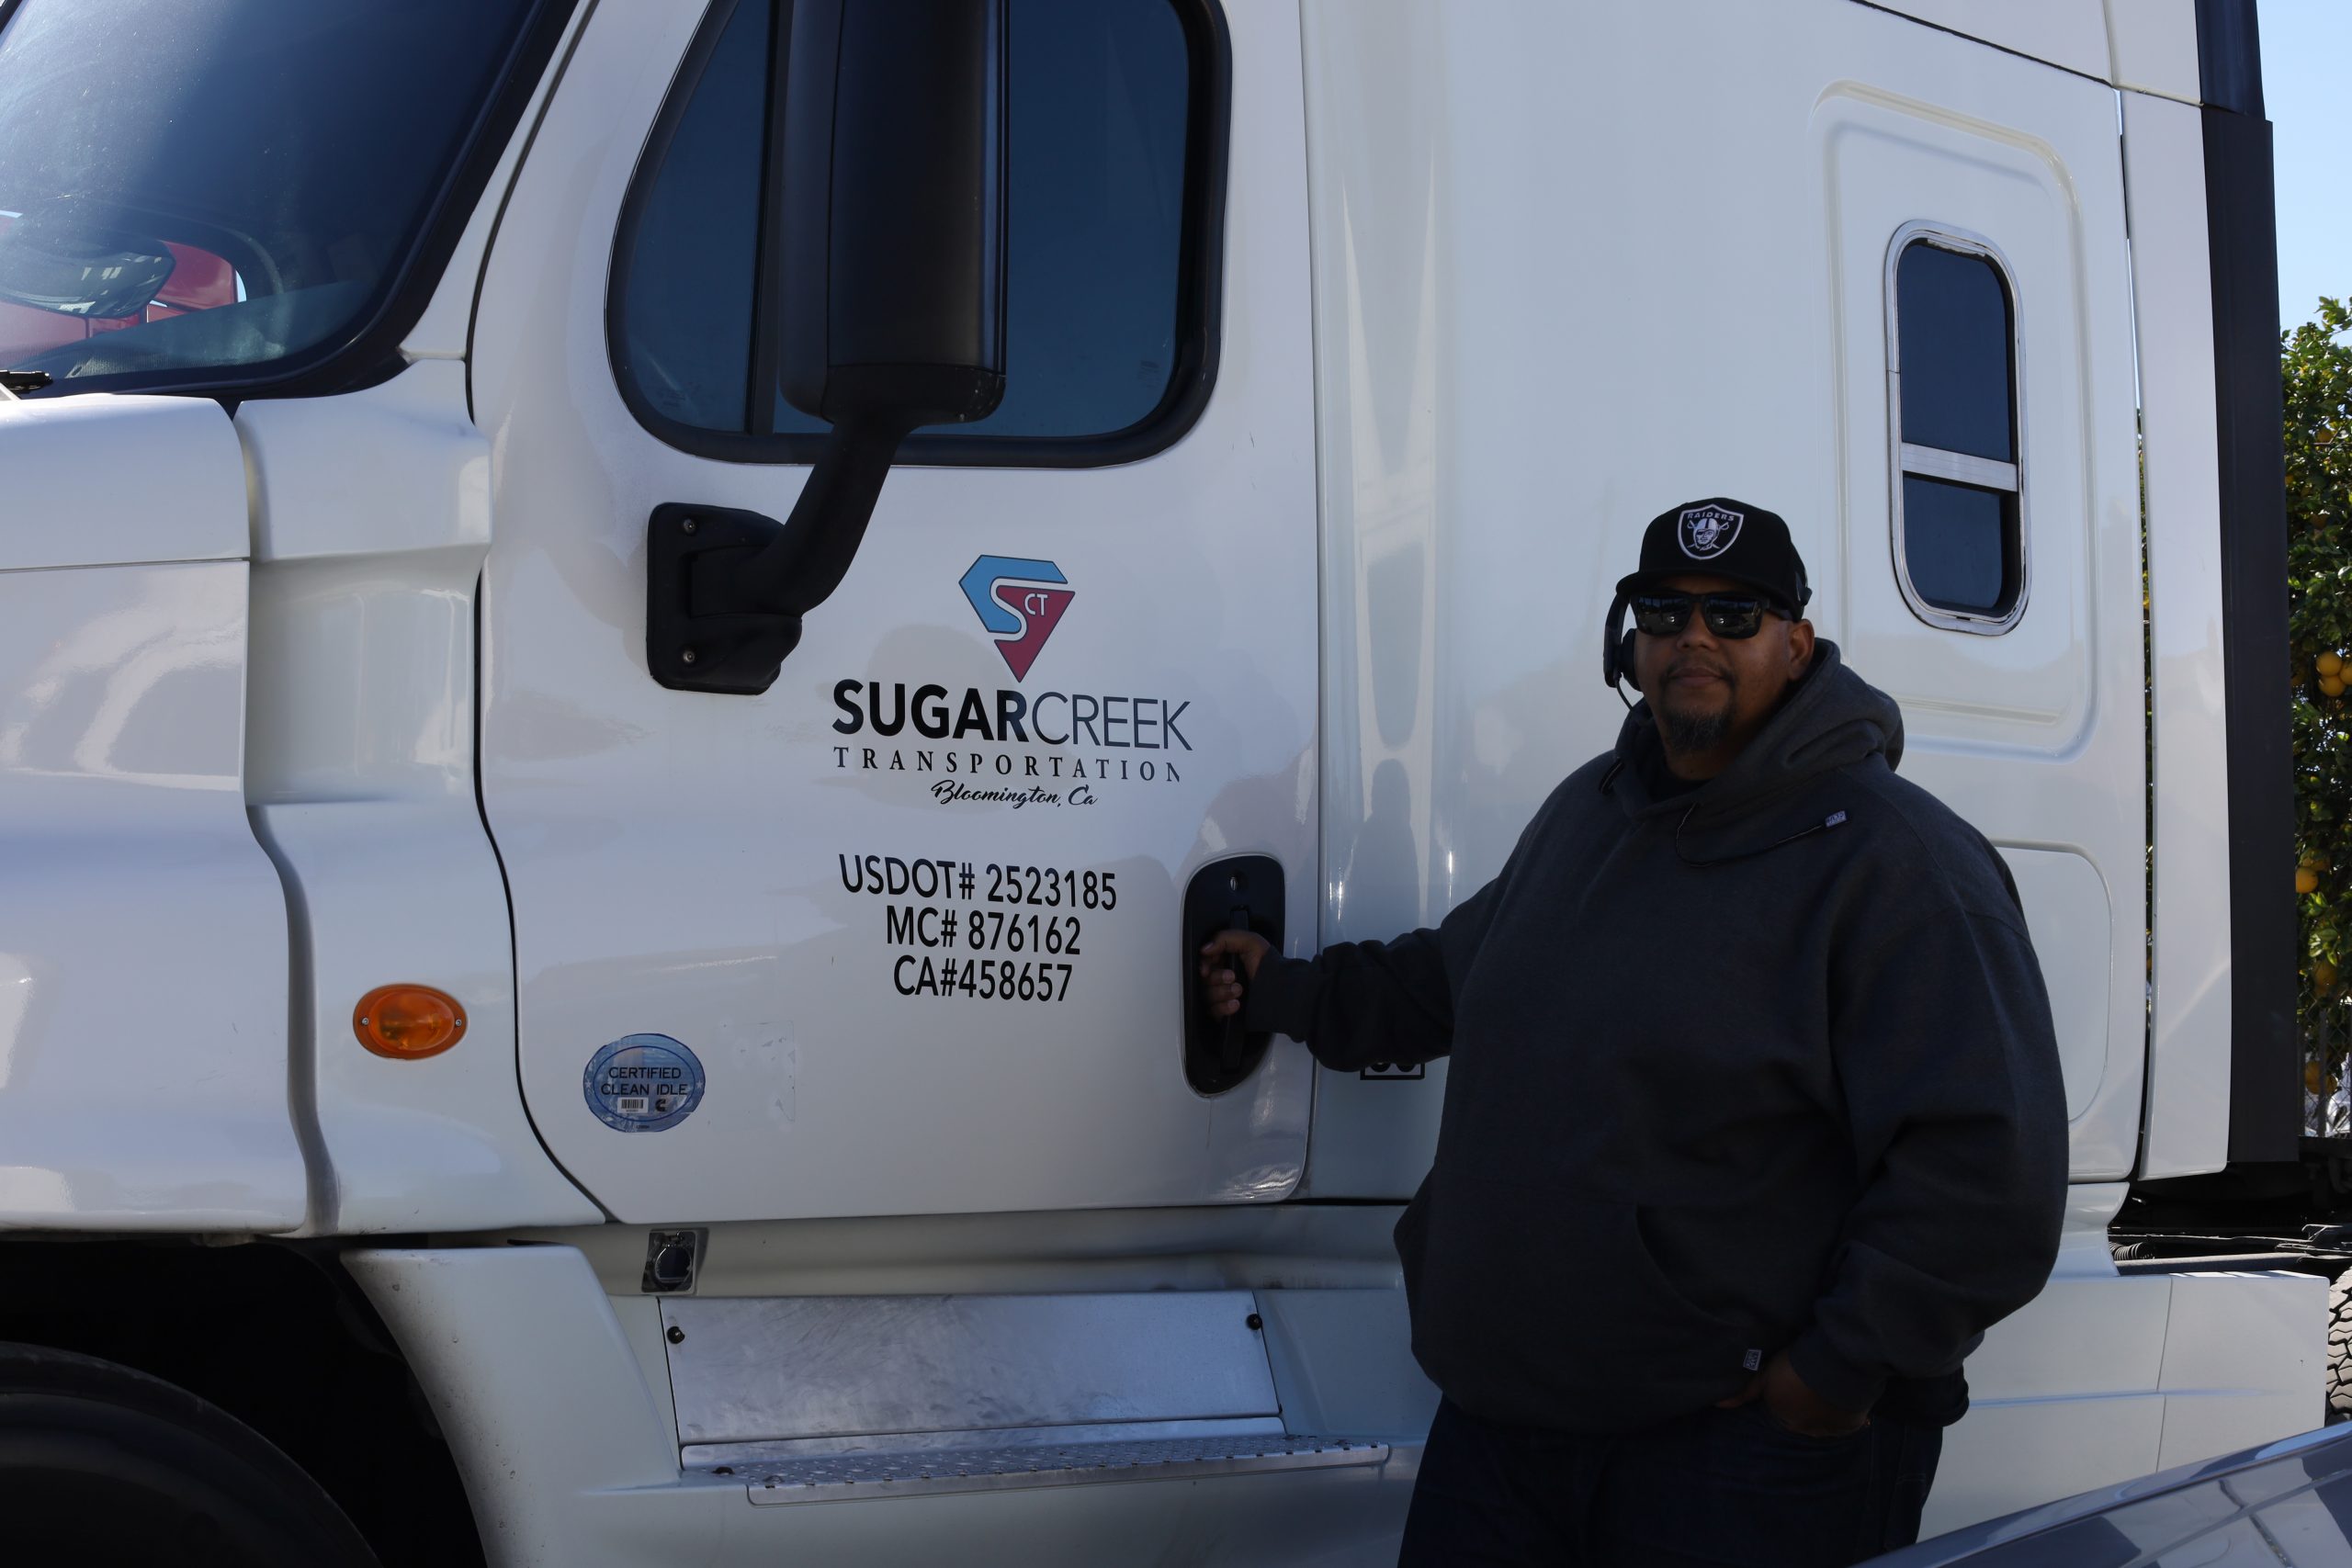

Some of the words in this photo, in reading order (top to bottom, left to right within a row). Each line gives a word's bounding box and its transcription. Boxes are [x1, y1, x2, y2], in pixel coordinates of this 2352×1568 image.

[1687, 512, 1735, 521] RAIDERS
[832, 679, 1193, 751] SUGARCREEK
[833, 747, 1181, 784] TRANSPORTATION
[931, 779, 1061, 809] Bloomington,
[1068, 784, 1098, 806] Ca
[839, 853, 976, 900] USDOT#
[986, 863, 1117, 910] 2523185
[886, 905, 957, 948] MC#
[968, 909, 1081, 955] 876162
[893, 954, 1073, 1002] CA#458657
[601, 1084, 650, 1096] CLEAN
[657, 1084, 688, 1096] IDLE
[608, 1066, 682, 1079] CERTIFIED
